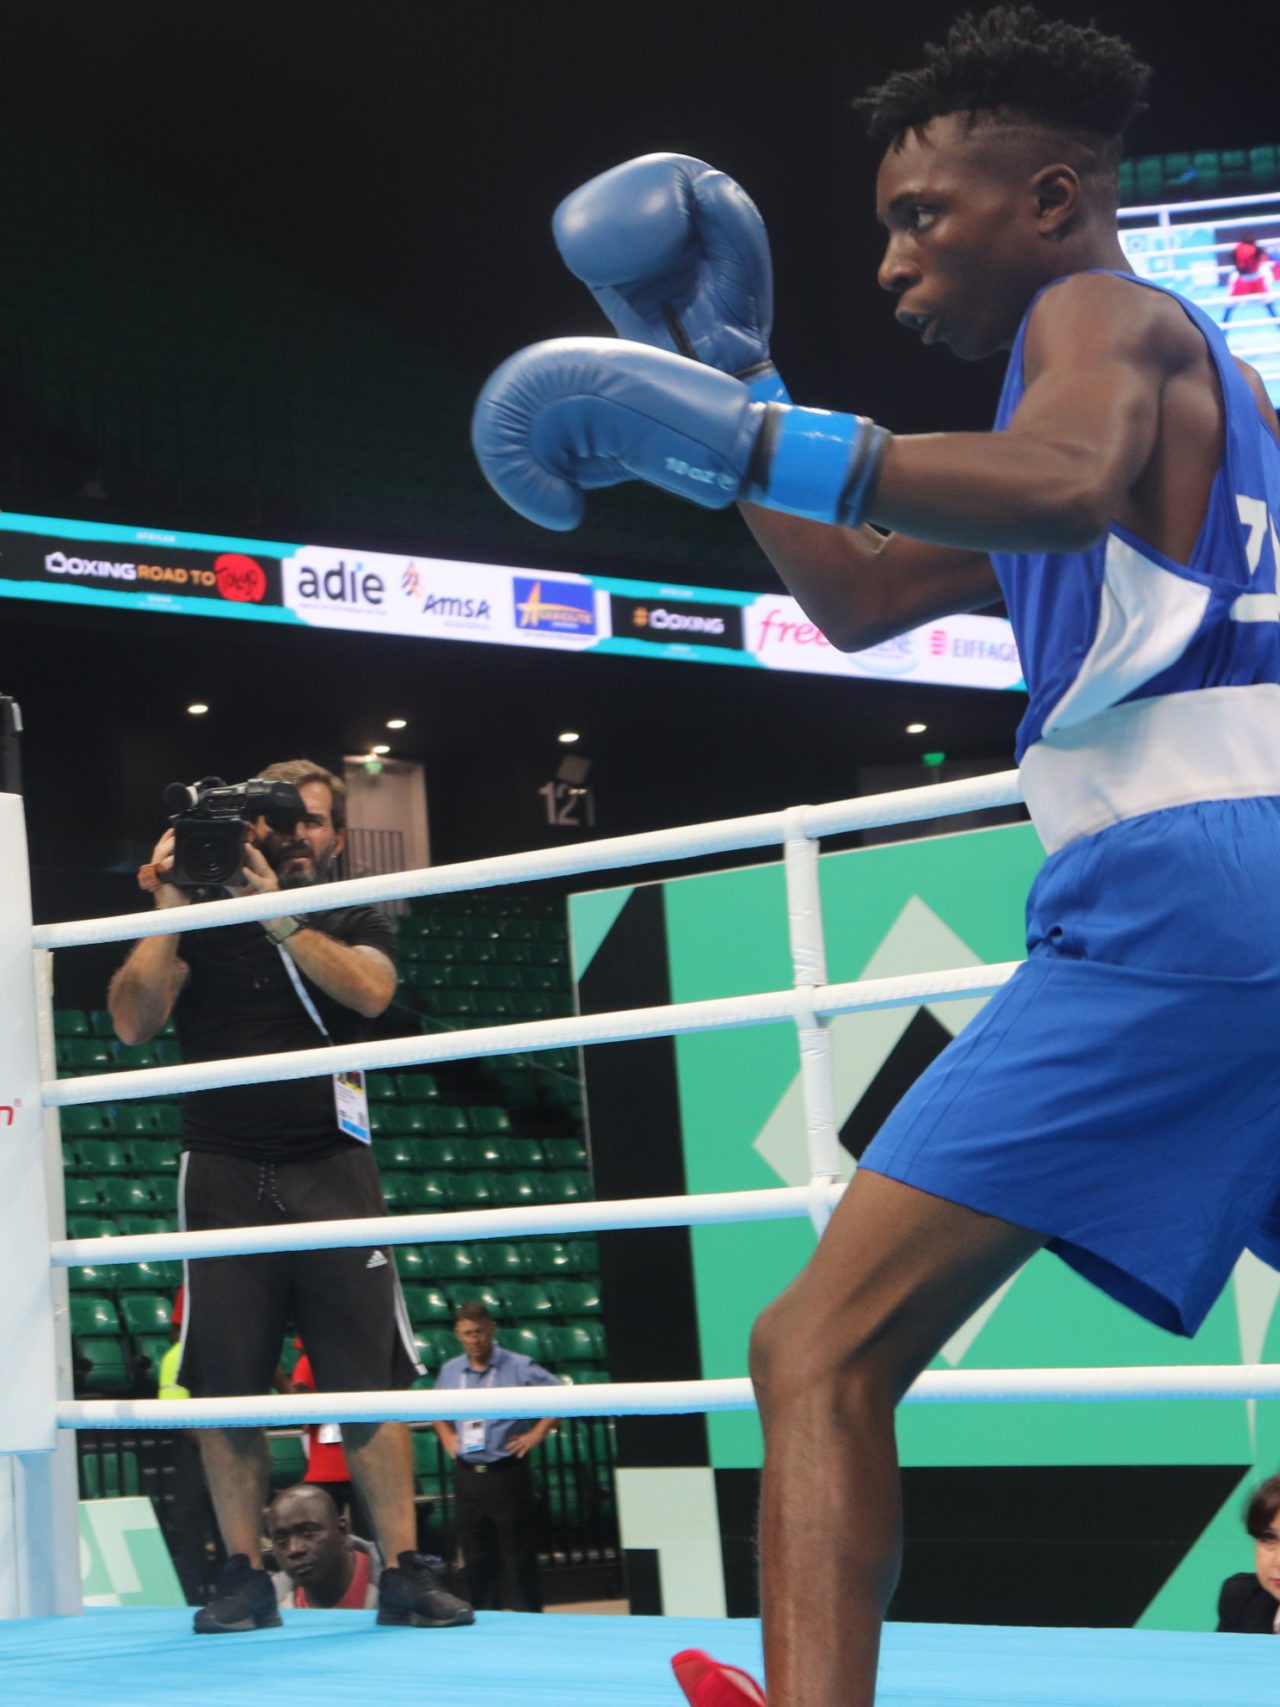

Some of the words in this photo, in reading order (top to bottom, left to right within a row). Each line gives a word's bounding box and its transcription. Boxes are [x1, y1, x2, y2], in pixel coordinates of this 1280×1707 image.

[137, 564, 188, 584] ROAD
[190, 569, 216, 586] TO
[298, 560, 386, 605] adie
